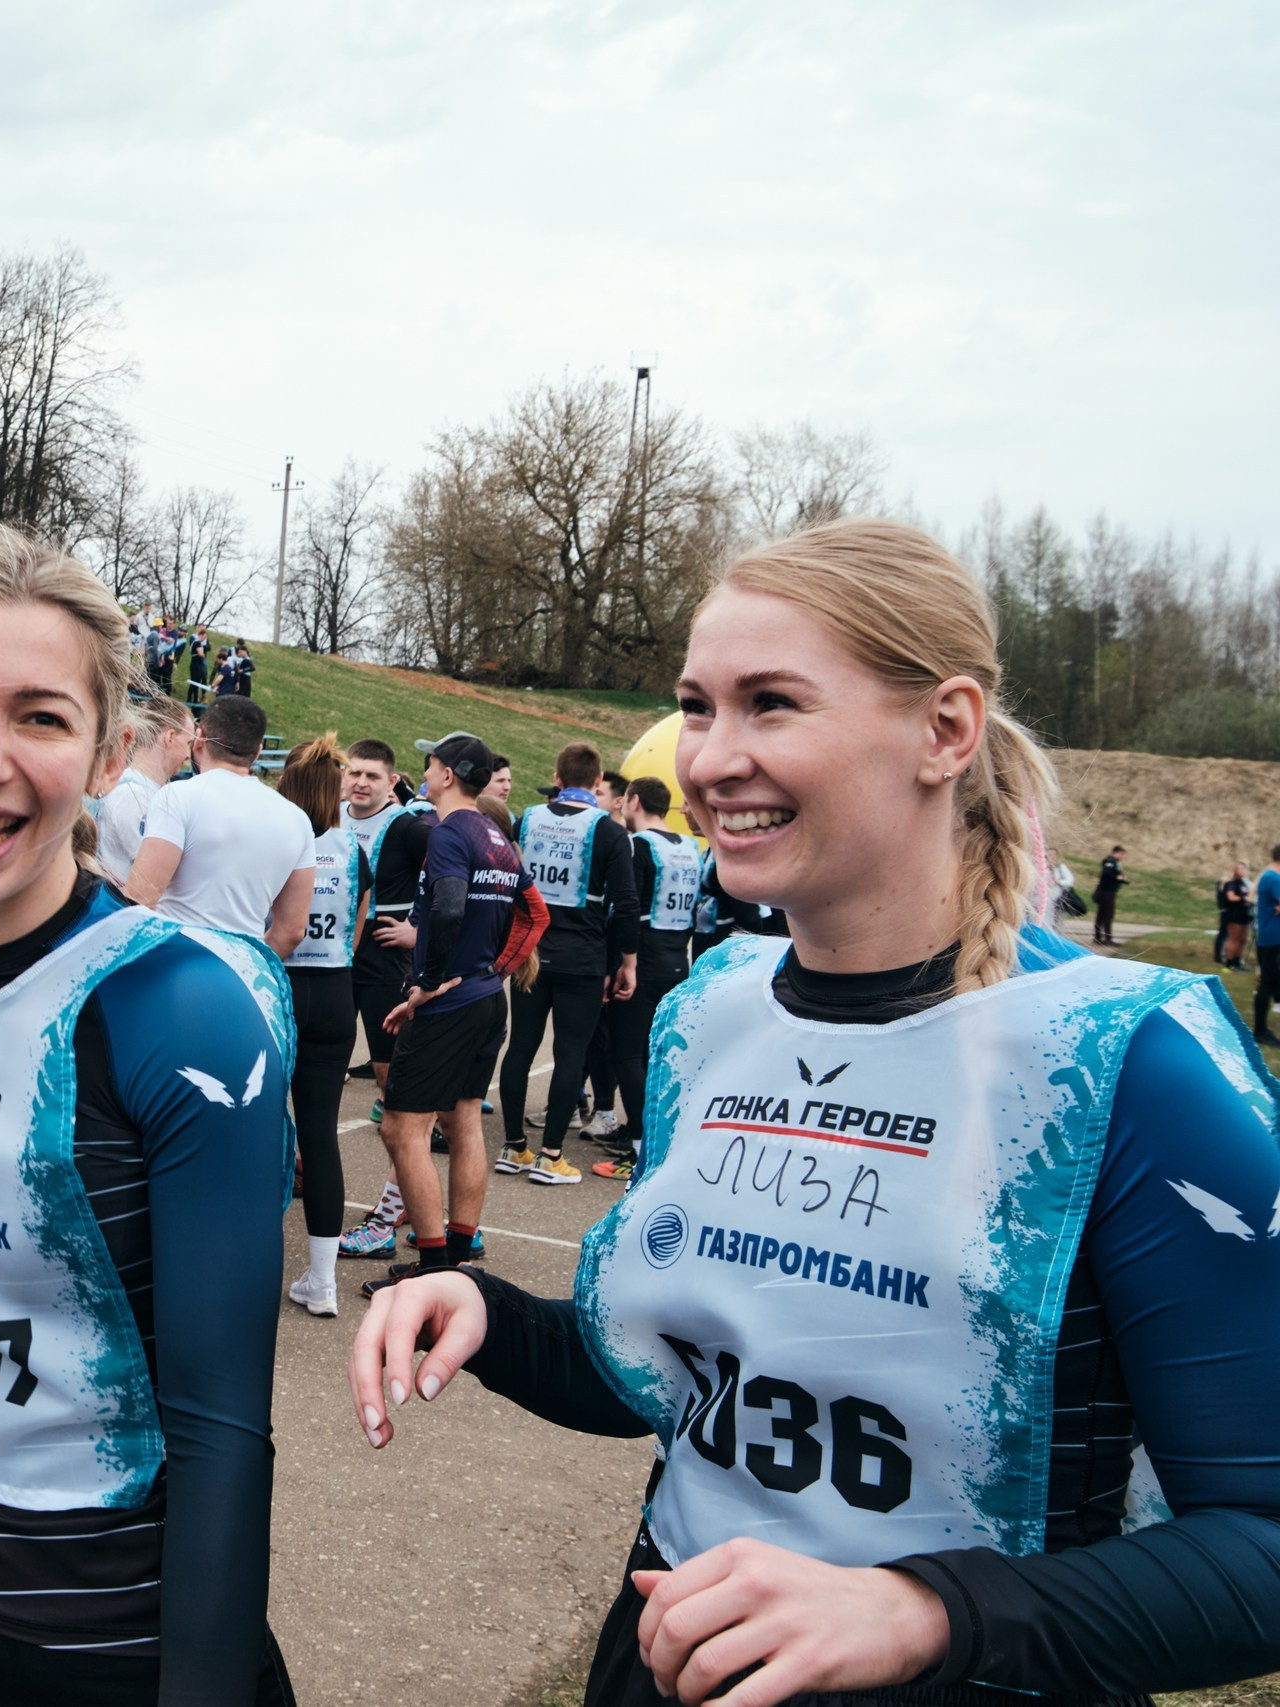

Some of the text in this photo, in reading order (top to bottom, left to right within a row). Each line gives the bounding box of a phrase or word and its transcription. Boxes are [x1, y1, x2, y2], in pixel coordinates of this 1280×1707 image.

[314, 886, 336, 895] таль
[529, 862, 569, 886] 5104
[304, 913, 336, 940] 52
[704, 1095, 937, 1145] ГОНКА ГЕРОЕВ
[697, 1136, 891, 1227] ЛИЗА
[697, 1225, 930, 1309] ГАЗПРОМБАНК
[657, 1333, 912, 1513] 5036
